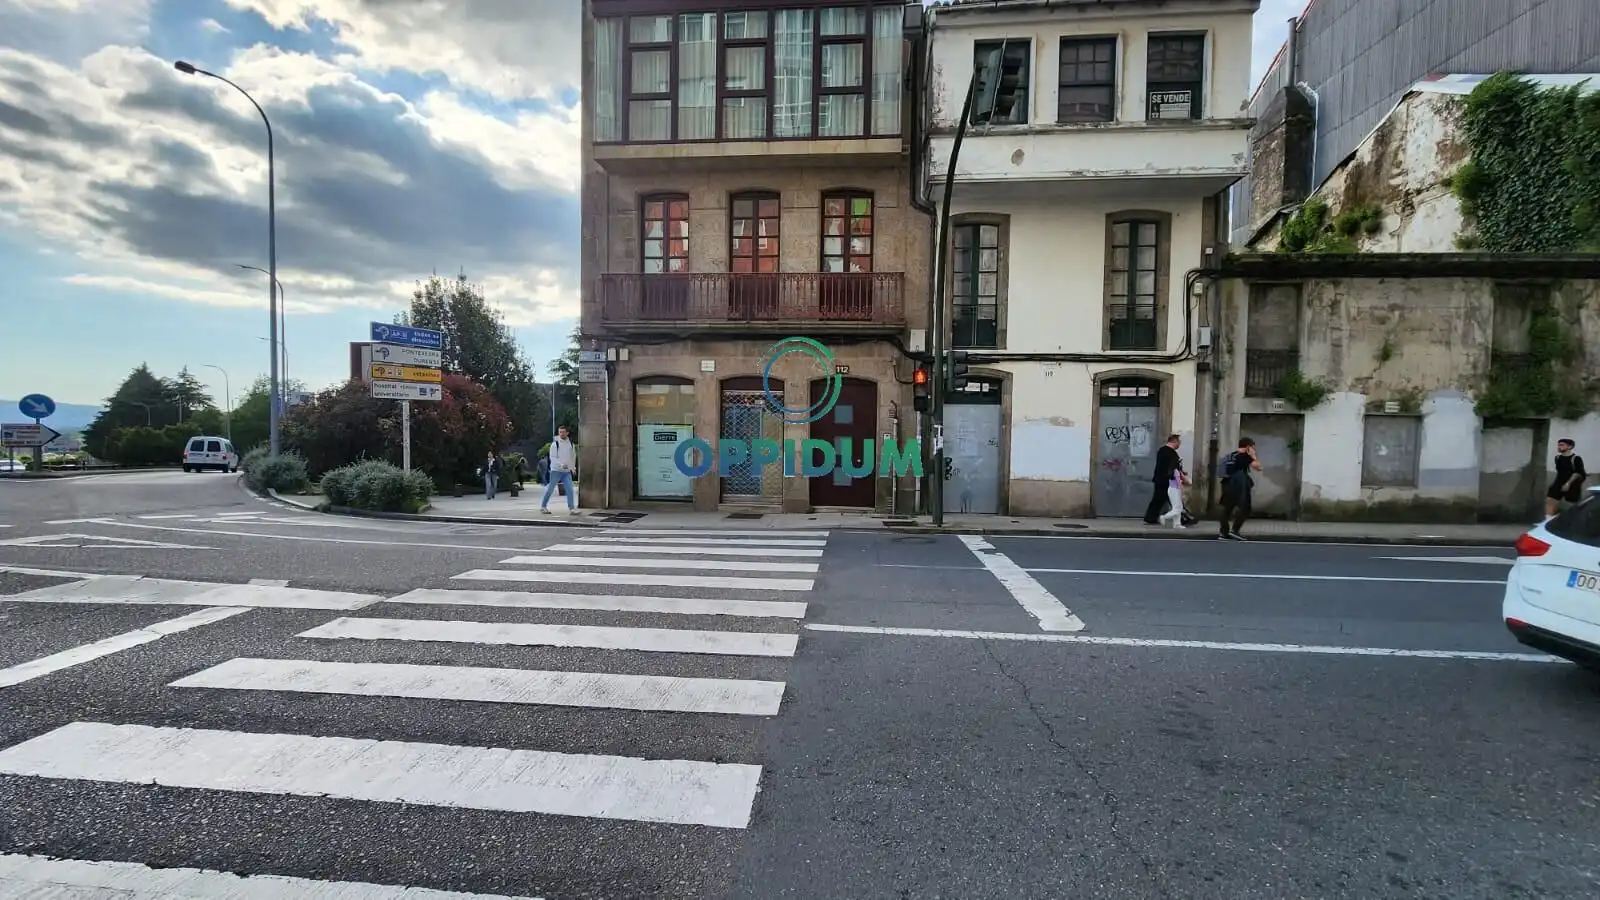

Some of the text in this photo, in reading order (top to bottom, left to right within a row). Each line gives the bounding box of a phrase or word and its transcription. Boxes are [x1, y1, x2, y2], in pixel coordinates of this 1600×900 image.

[1151, 93, 1190, 103] SE VENDE
[1577, 574, 1600, 591] 00
